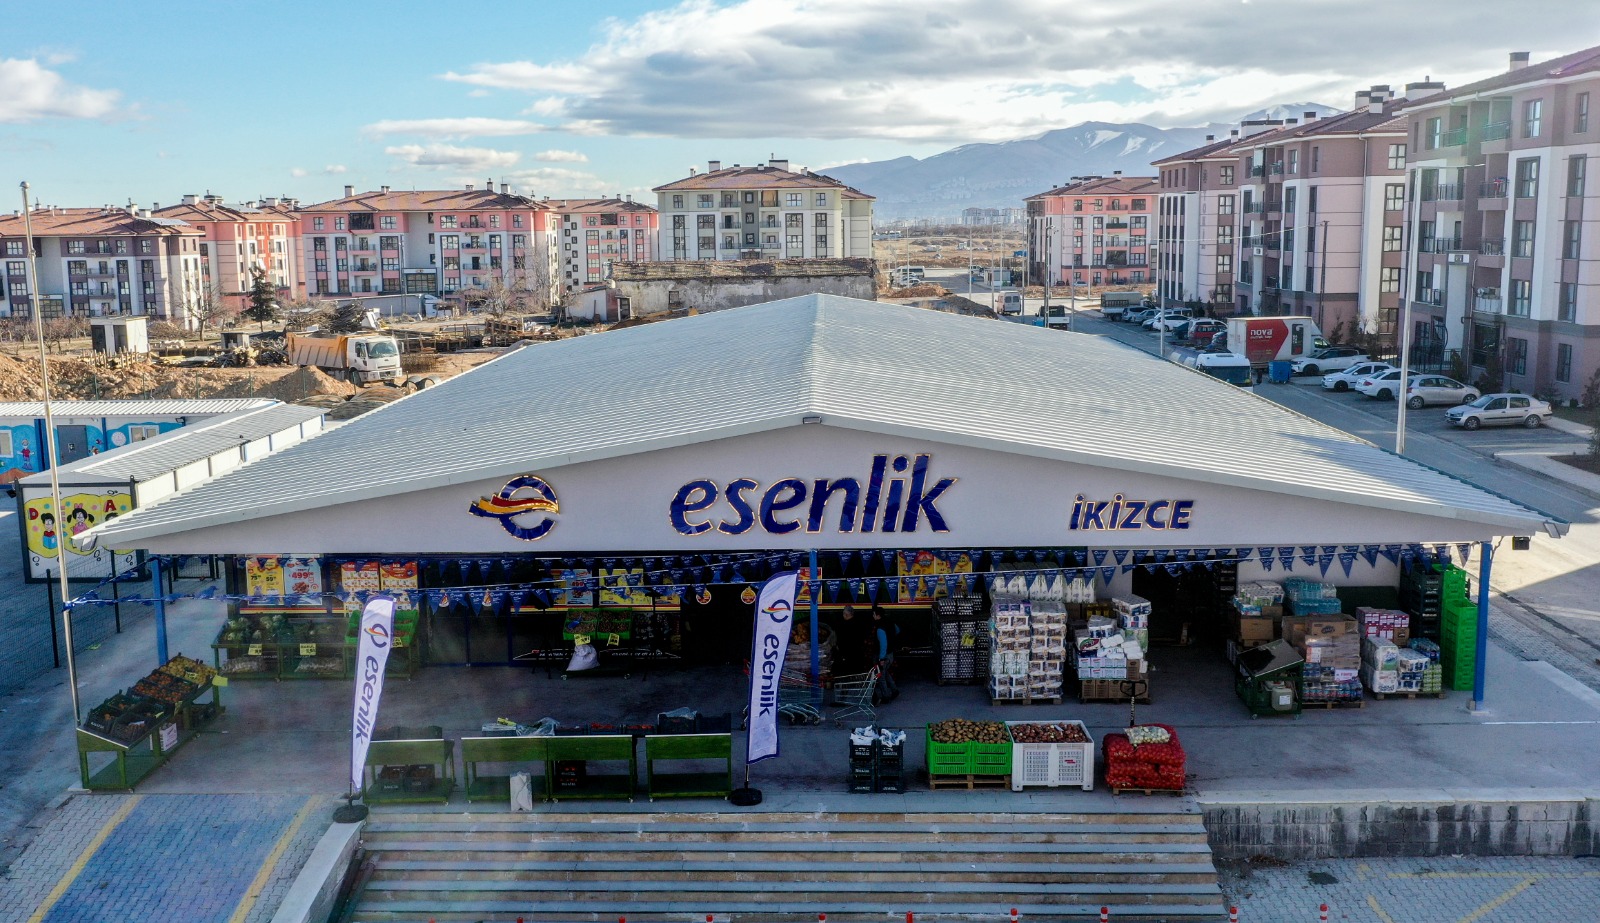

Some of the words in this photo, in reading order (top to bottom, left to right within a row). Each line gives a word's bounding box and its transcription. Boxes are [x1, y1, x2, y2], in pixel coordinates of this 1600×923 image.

[104, 499, 117, 513] A
[669, 454, 960, 536] esenlik
[1069, 493, 1195, 531] İKİZCE
[355, 655, 379, 745] esenlik
[759, 633, 780, 718] esenlik
